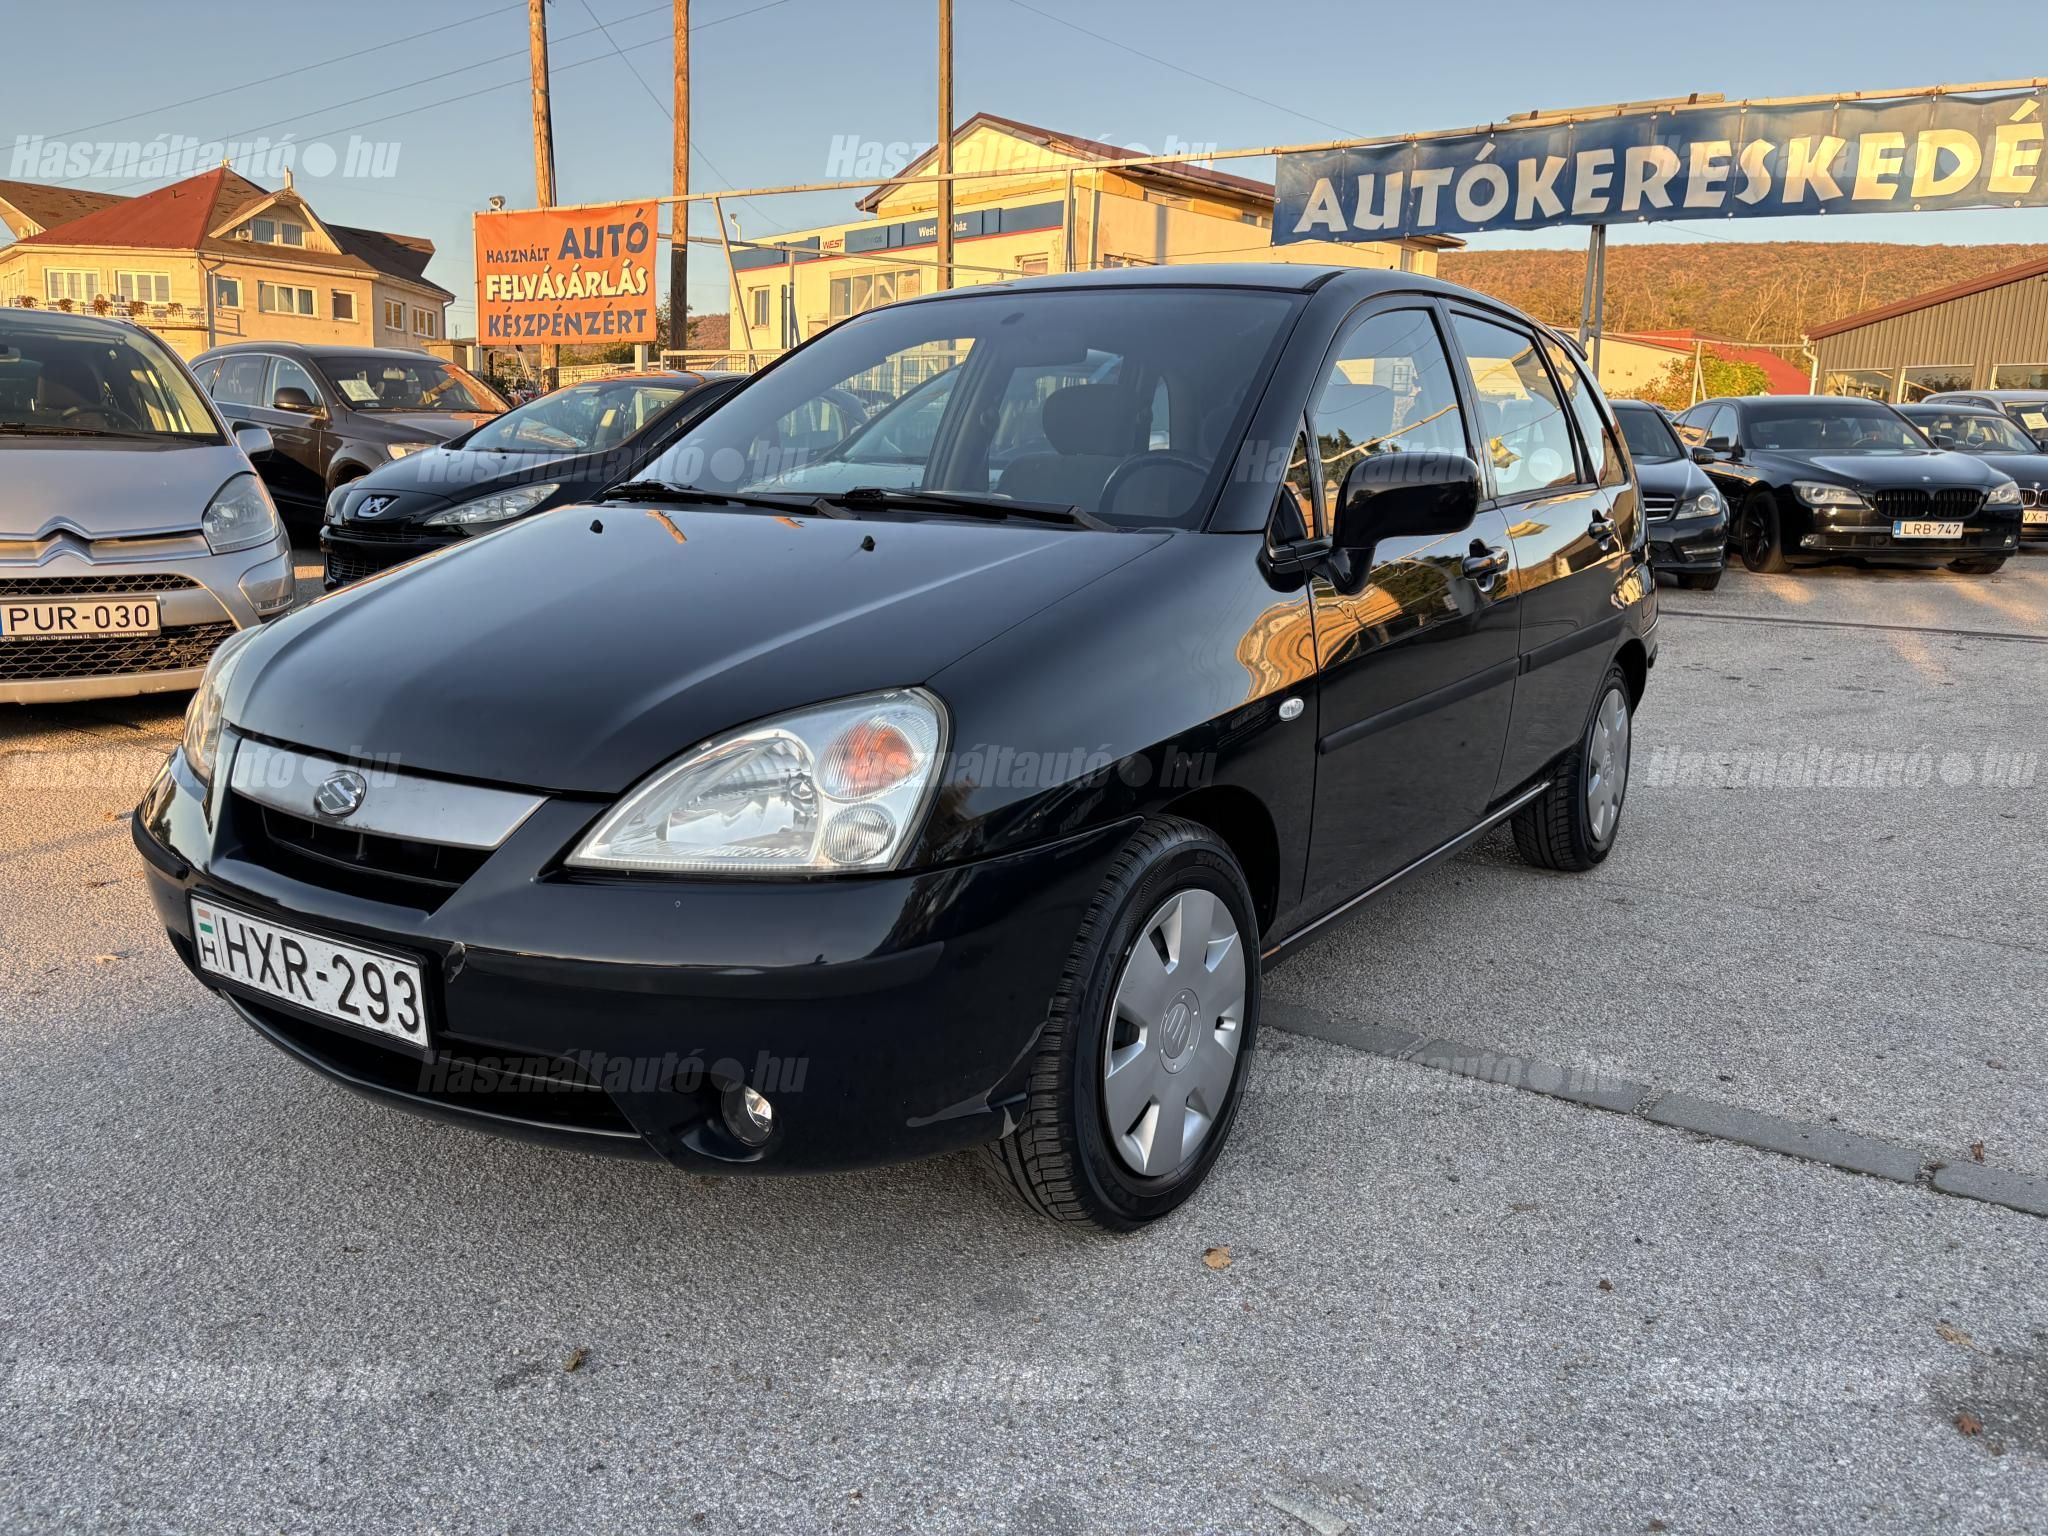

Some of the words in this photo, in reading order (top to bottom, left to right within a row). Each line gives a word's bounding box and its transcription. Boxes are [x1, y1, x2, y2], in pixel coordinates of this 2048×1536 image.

[1292, 99, 2046, 233] AUTÓKERESKEDÉ
[486, 244, 549, 263] HASZNÁLT
[558, 208, 649, 260] AUTÓ
[822, 238, 844, 249] WEST
[918, 226, 937, 237] West
[486, 258, 648, 303] FELVÁSÁRLÁS
[488, 302, 647, 337] KÉSZPÉNZÉRT
[1903, 523, 1960, 535] LRB-747
[9, 604, 151, 632] PUR-030
[221, 917, 420, 1035] HXR-293
